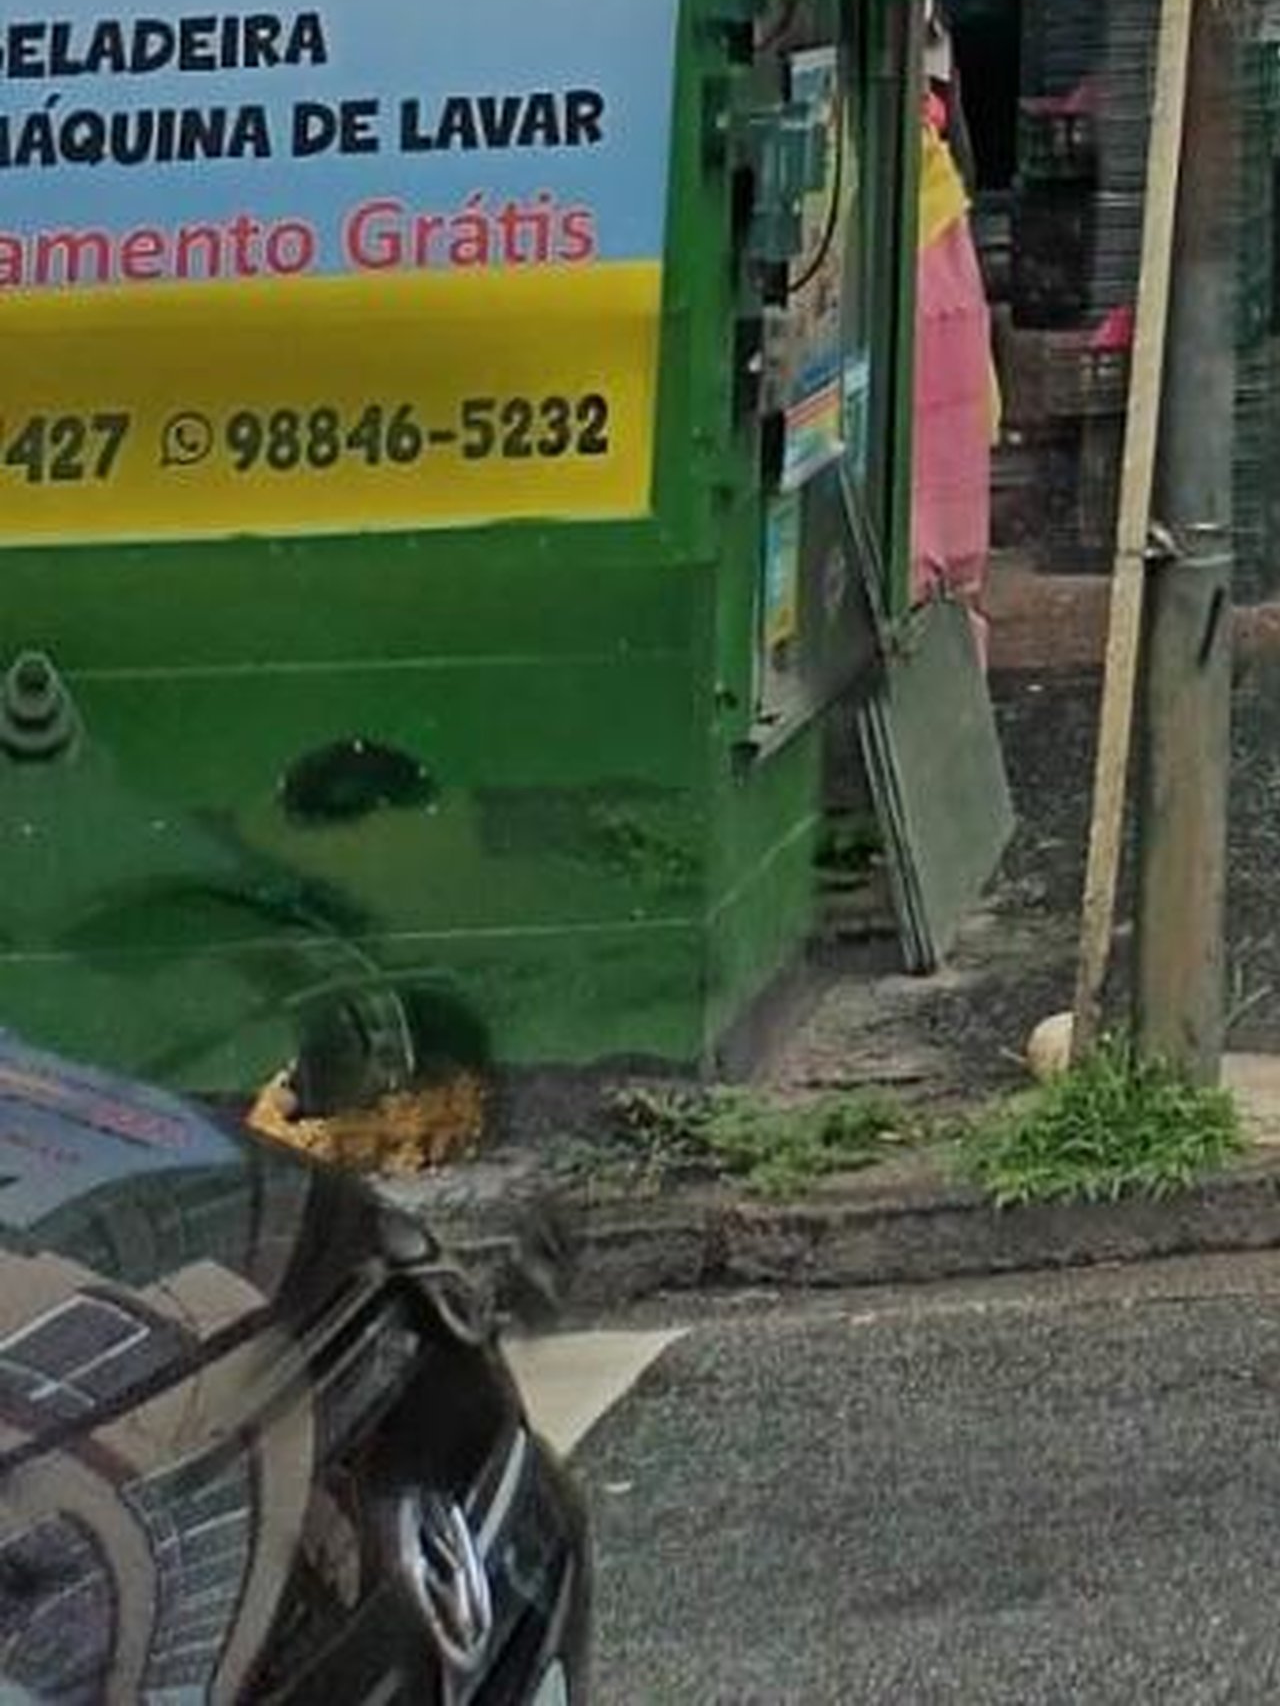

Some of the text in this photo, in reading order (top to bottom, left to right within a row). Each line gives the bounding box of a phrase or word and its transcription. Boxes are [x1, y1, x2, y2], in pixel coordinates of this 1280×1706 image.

[0, 13, 328, 78] ELADEIRA
[0, 90, 604, 167] ÁQUINA DE LAVAR
[347, 191, 594, 271] Grátis
[5, 394, 608, 483] 427 98846-5232
